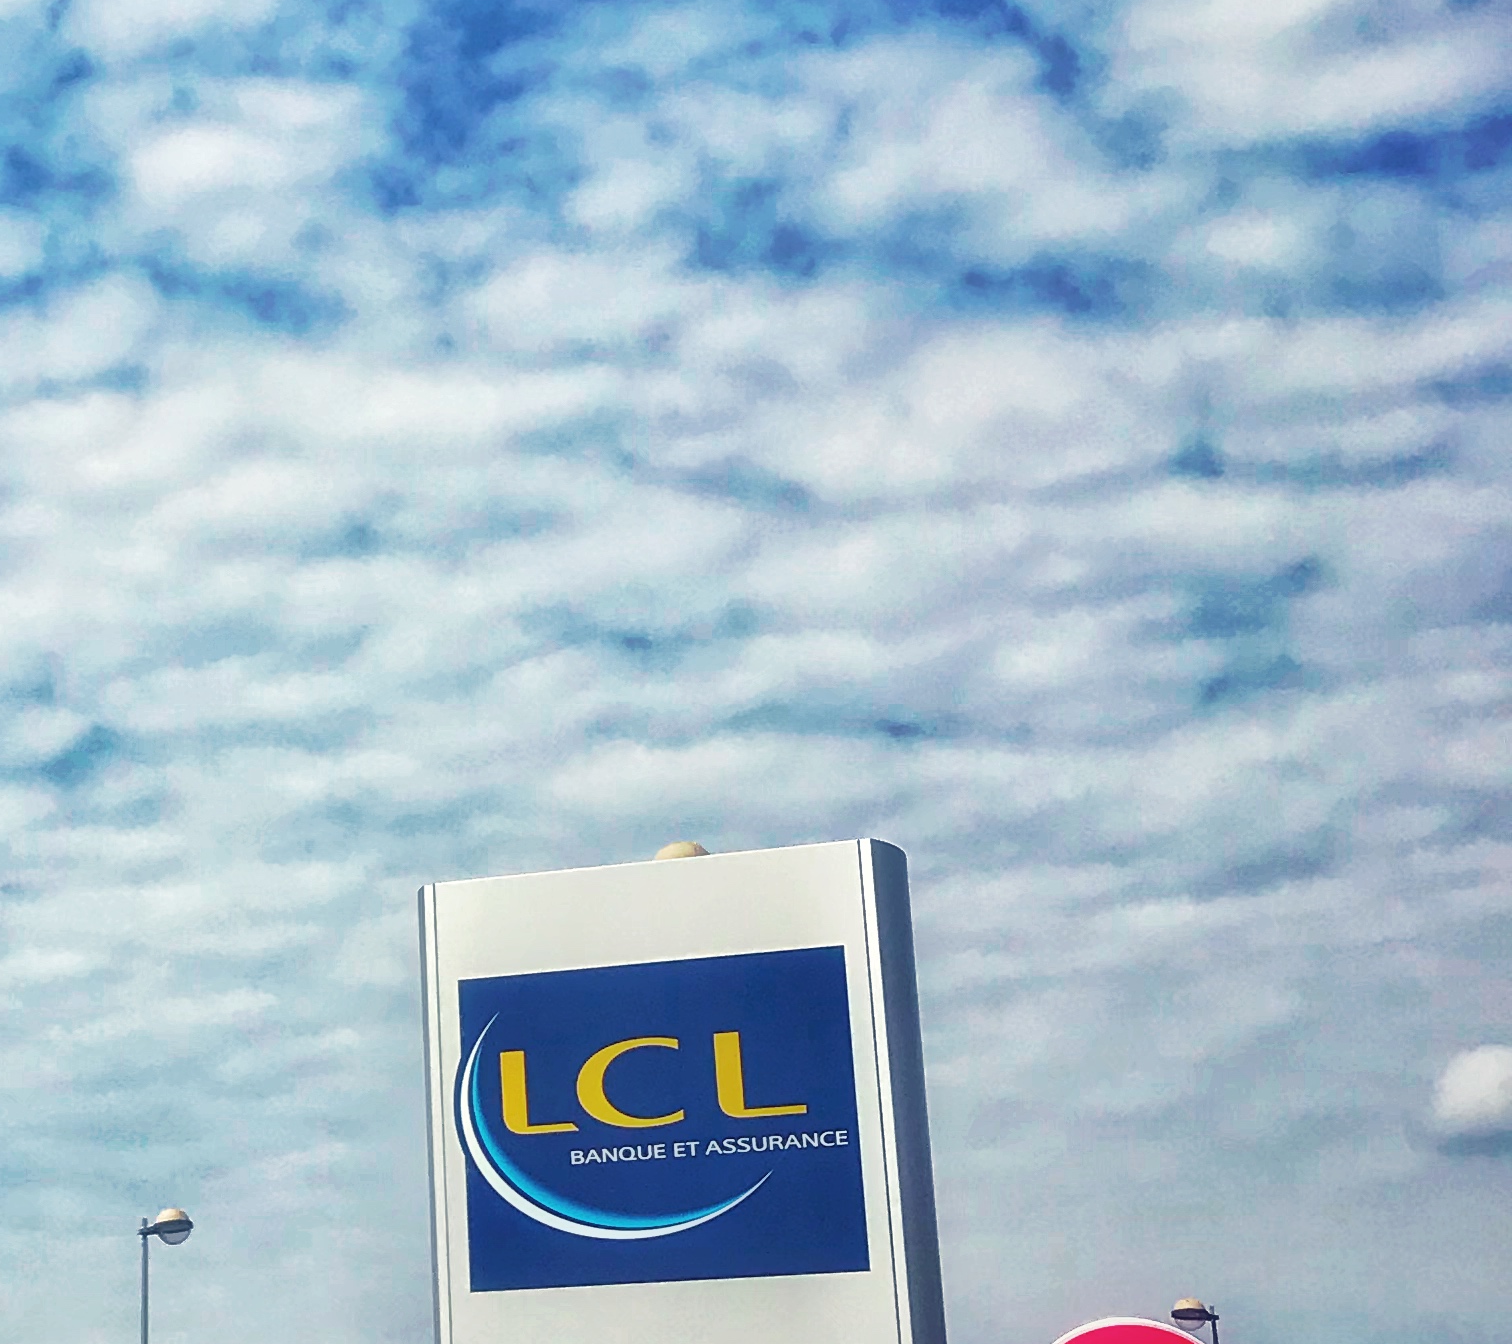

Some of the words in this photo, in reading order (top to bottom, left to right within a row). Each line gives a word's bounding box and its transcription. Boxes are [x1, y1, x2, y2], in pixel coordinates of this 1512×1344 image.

[499, 1031, 808, 1135] LCL
[570, 1143, 667, 1165] BANQUE
[673, 1141, 700, 1158] ET
[705, 1130, 849, 1156] ASSURANCE
